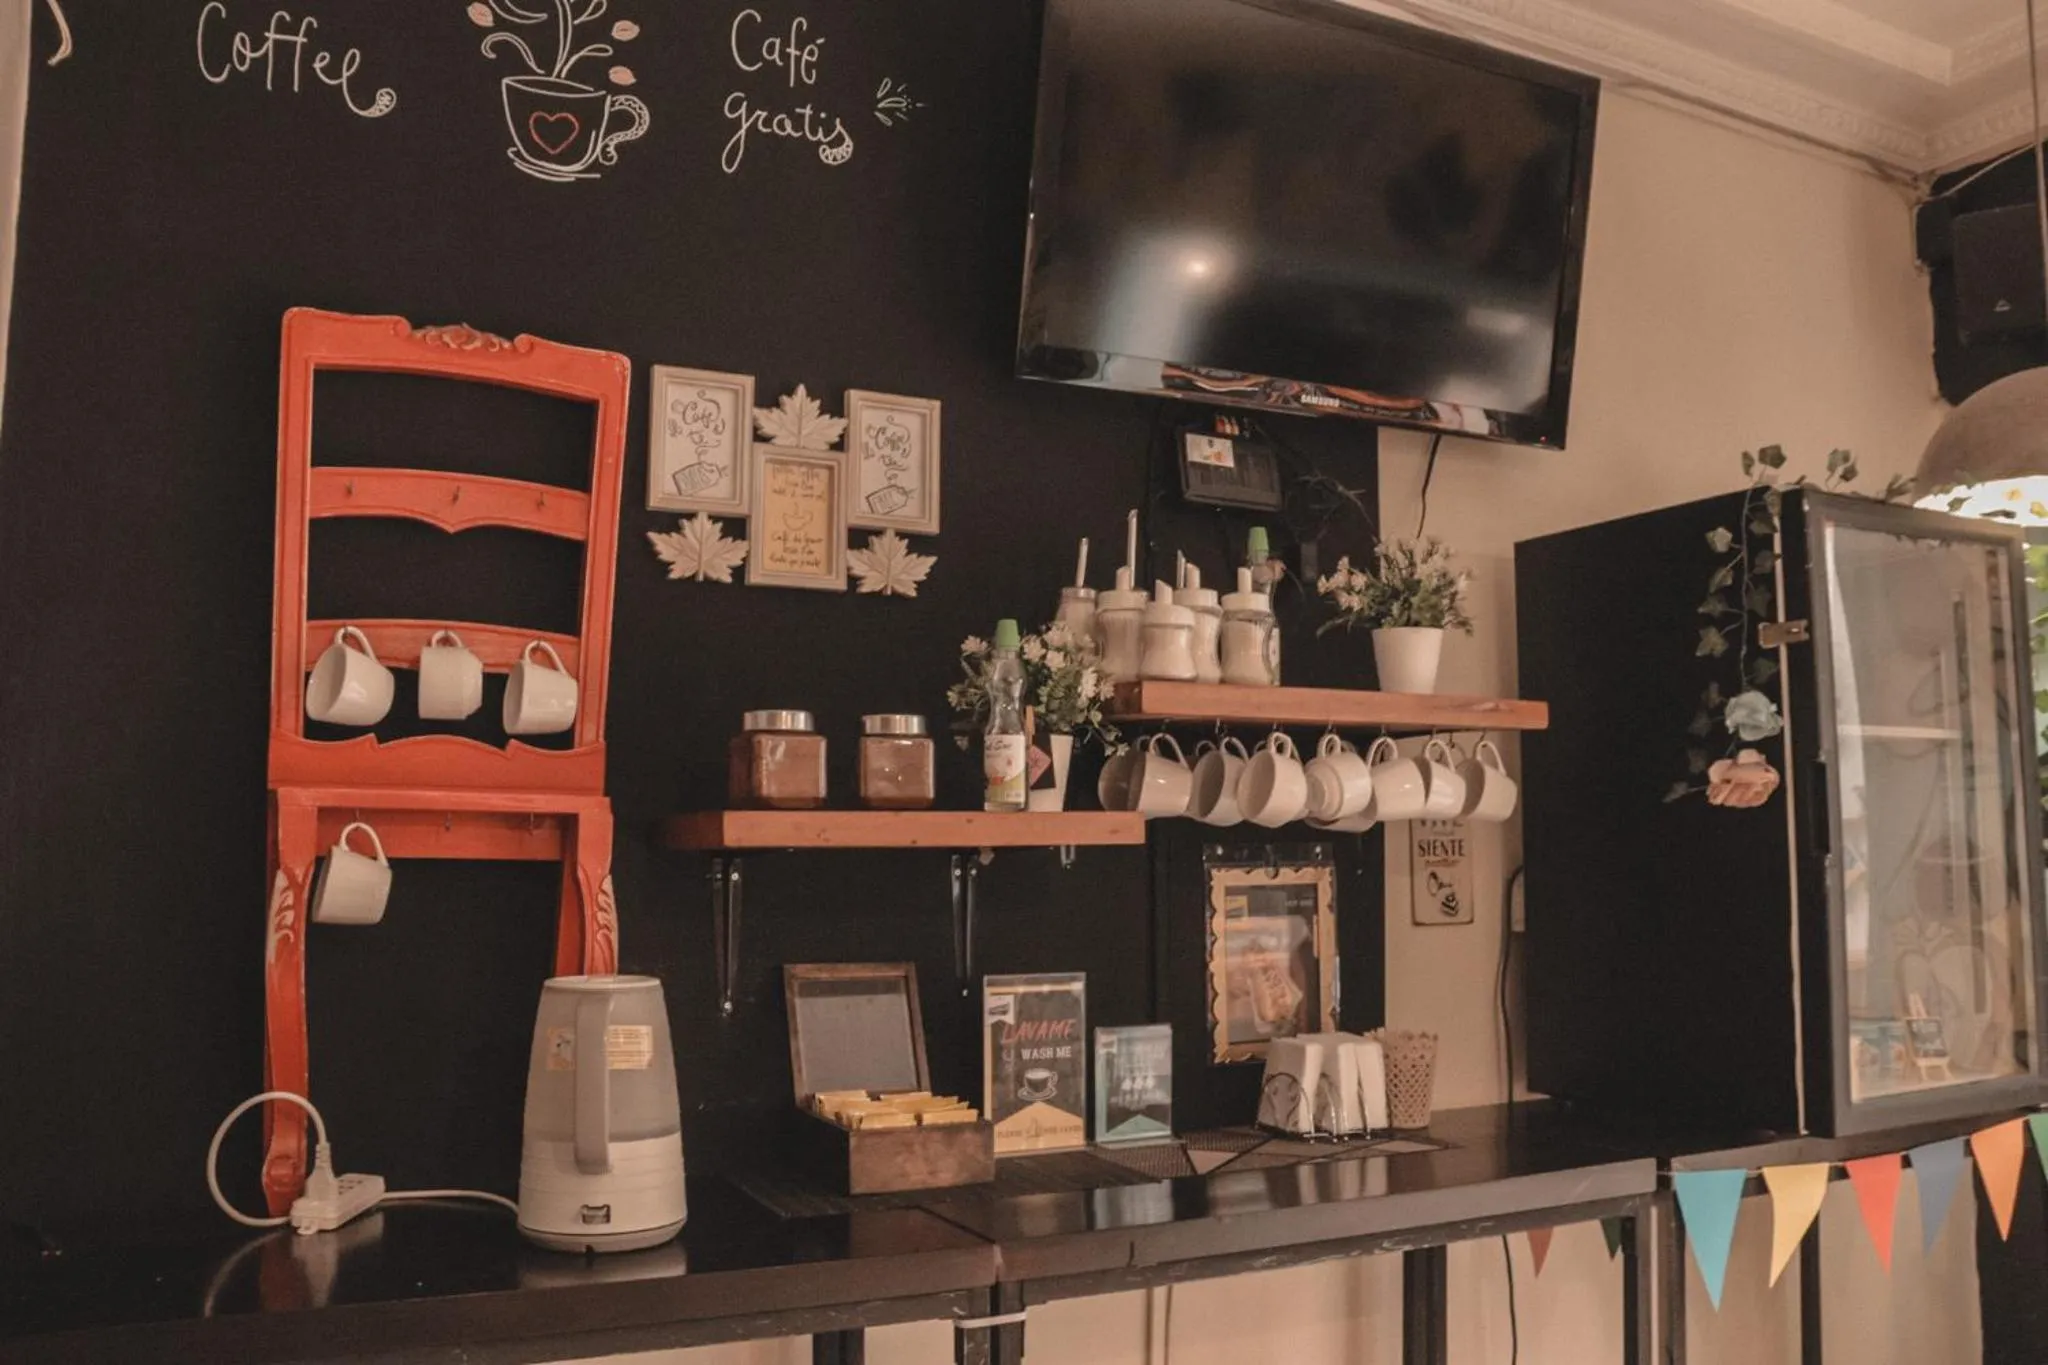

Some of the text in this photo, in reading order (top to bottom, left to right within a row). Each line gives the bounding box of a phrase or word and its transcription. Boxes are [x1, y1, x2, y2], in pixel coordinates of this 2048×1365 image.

[197, 1, 397, 117] Coffee
[731, 9, 826, 88] Café
[722, 92, 853, 174] gratis
[1417, 838, 1466, 858] SIENTE
[1020, 1045, 1073, 1060] WASH ME
